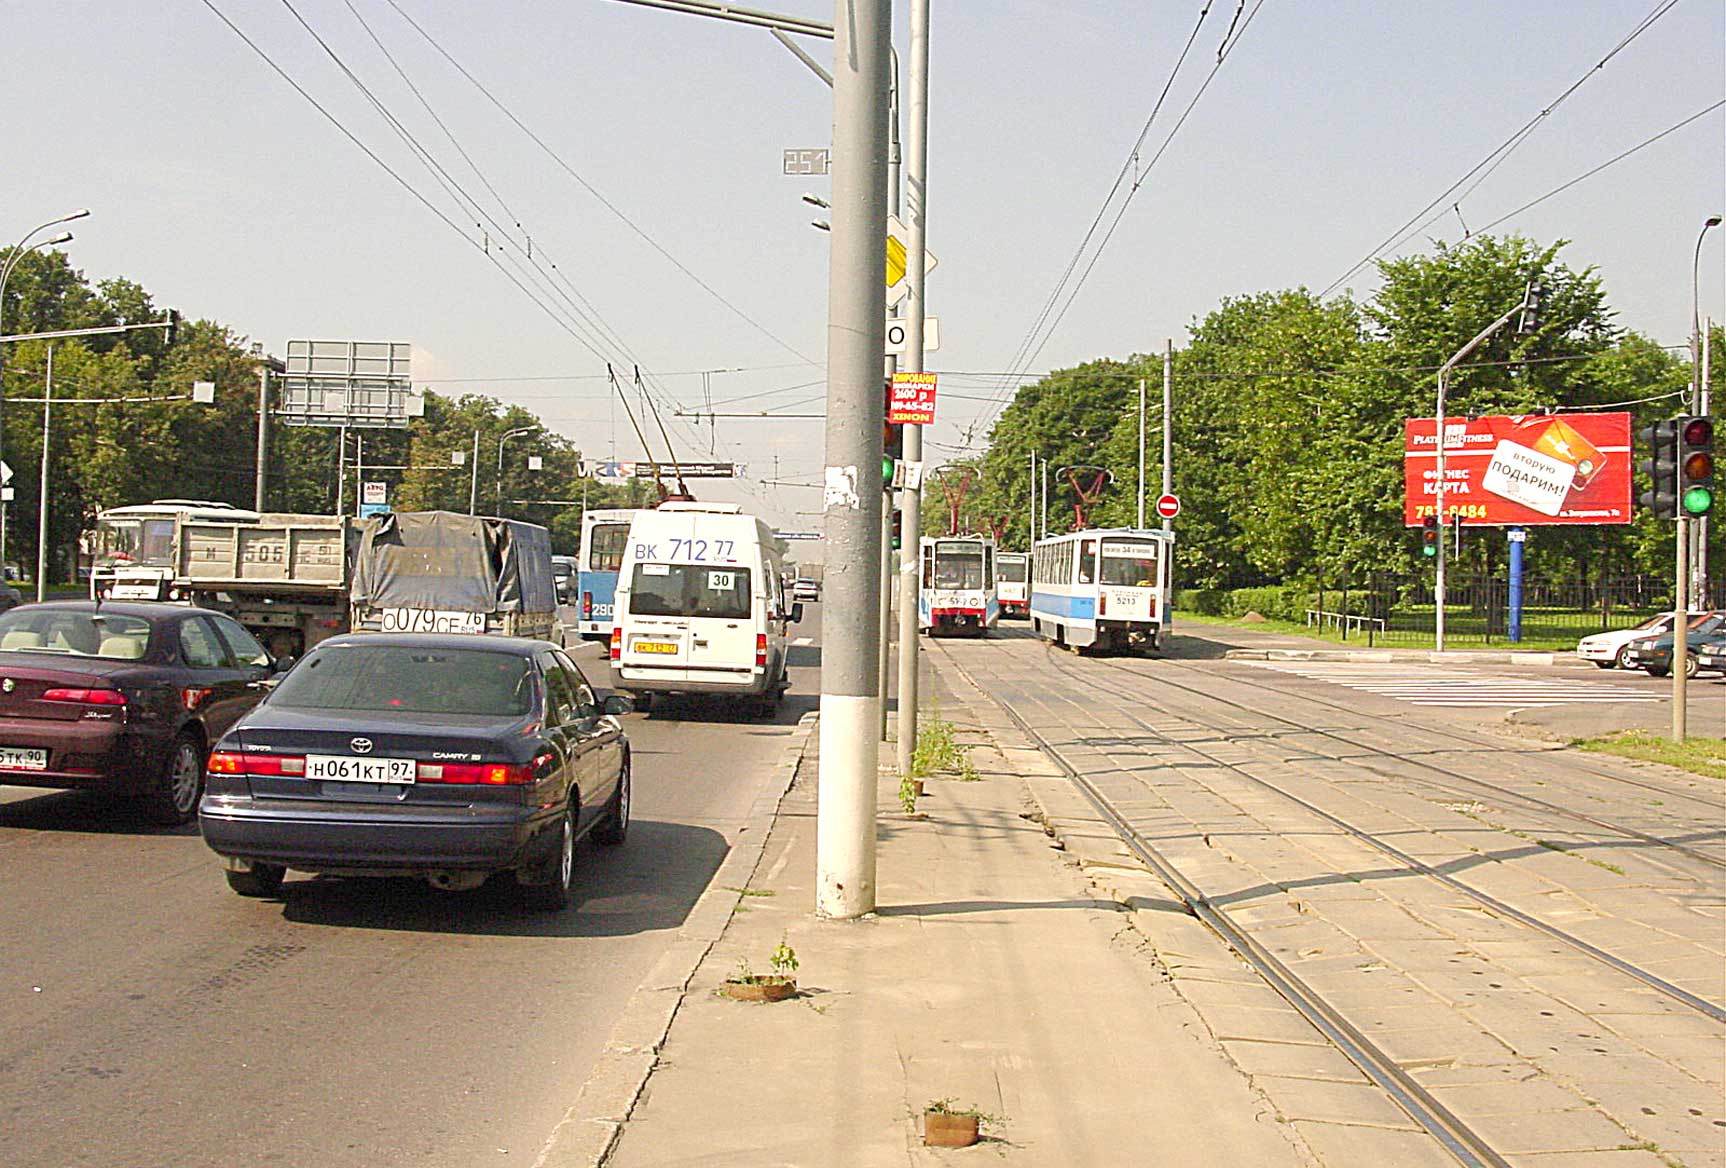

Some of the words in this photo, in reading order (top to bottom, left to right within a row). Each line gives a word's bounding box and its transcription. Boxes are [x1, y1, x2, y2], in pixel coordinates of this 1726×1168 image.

[1512, 453, 1556, 475] вторую
[1492, 461, 1566, 497] ПОДАРИМ!
[245, 545, 284, 562] 505
[669, 539, 708, 561] 712
[714, 540, 734, 556] 77
[713, 574, 729, 586] 30
[248, 744, 272, 752] TOYOTA
[27, 750, 41, 761] 90
[433, 752, 468, 760] CAMRY
[391, 762, 409, 776] 97
